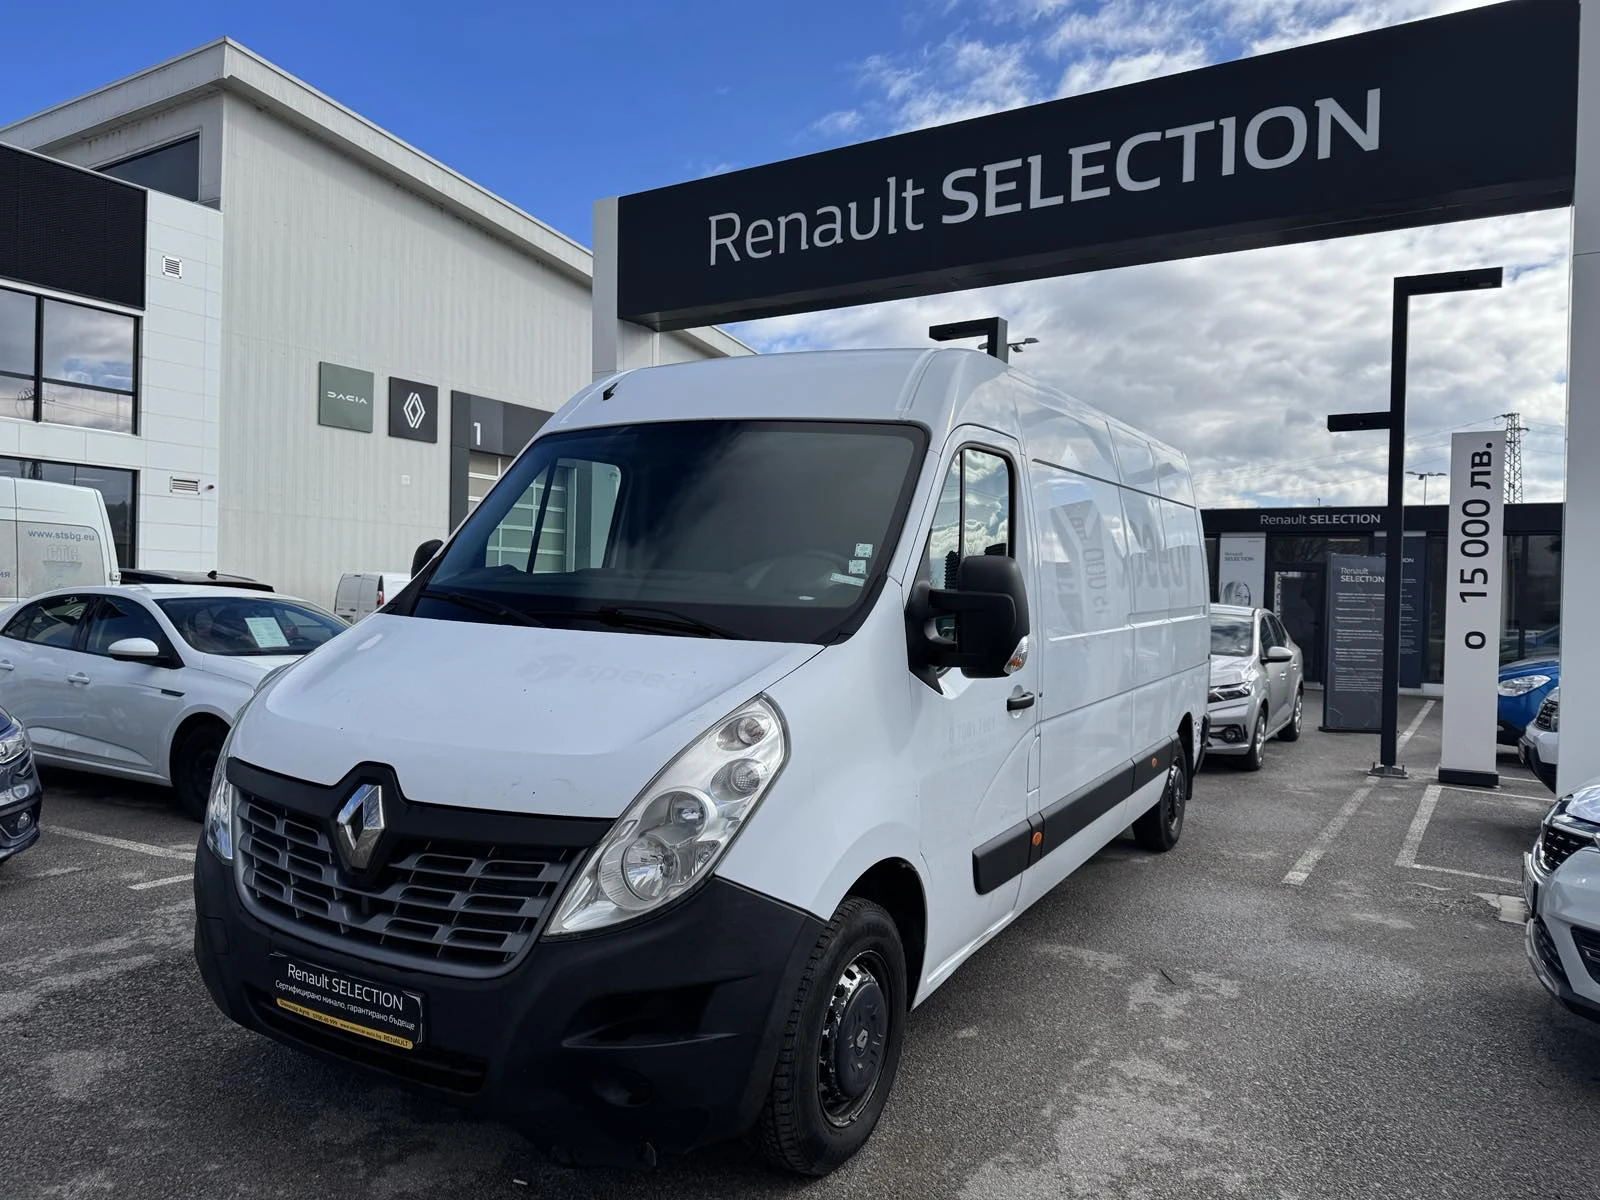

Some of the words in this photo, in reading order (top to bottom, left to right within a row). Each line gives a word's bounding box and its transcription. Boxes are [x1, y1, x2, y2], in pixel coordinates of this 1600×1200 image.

[708, 175, 924, 267] Renault
[941, 88, 1381, 225] SELECTION
[327, 391, 368, 405] DACIA
[473, 422, 481, 446] 1
[1470, 442, 1493, 490] лв.
[1260, 514, 1307, 525] Renault
[1309, 514, 1381, 525] SELECTION
[1460, 499, 1491, 558] 000
[28, 529, 95, 542] www.stsbg.eu
[1340, 567, 1369, 575] Renault
[1340, 575, 1385, 583] SELECTION
[1459, 568, 1489, 603] 15
[287, 963, 330, 990] Renault
[331, 978, 404, 1011] SELECTION
[275, 979, 322, 1003] Сертифицирано
[347, 1004, 388, 1024] гарантирано
[388, 1014, 416, 1031] бъдеще
[383, 1034, 409, 1048] RENAULT
